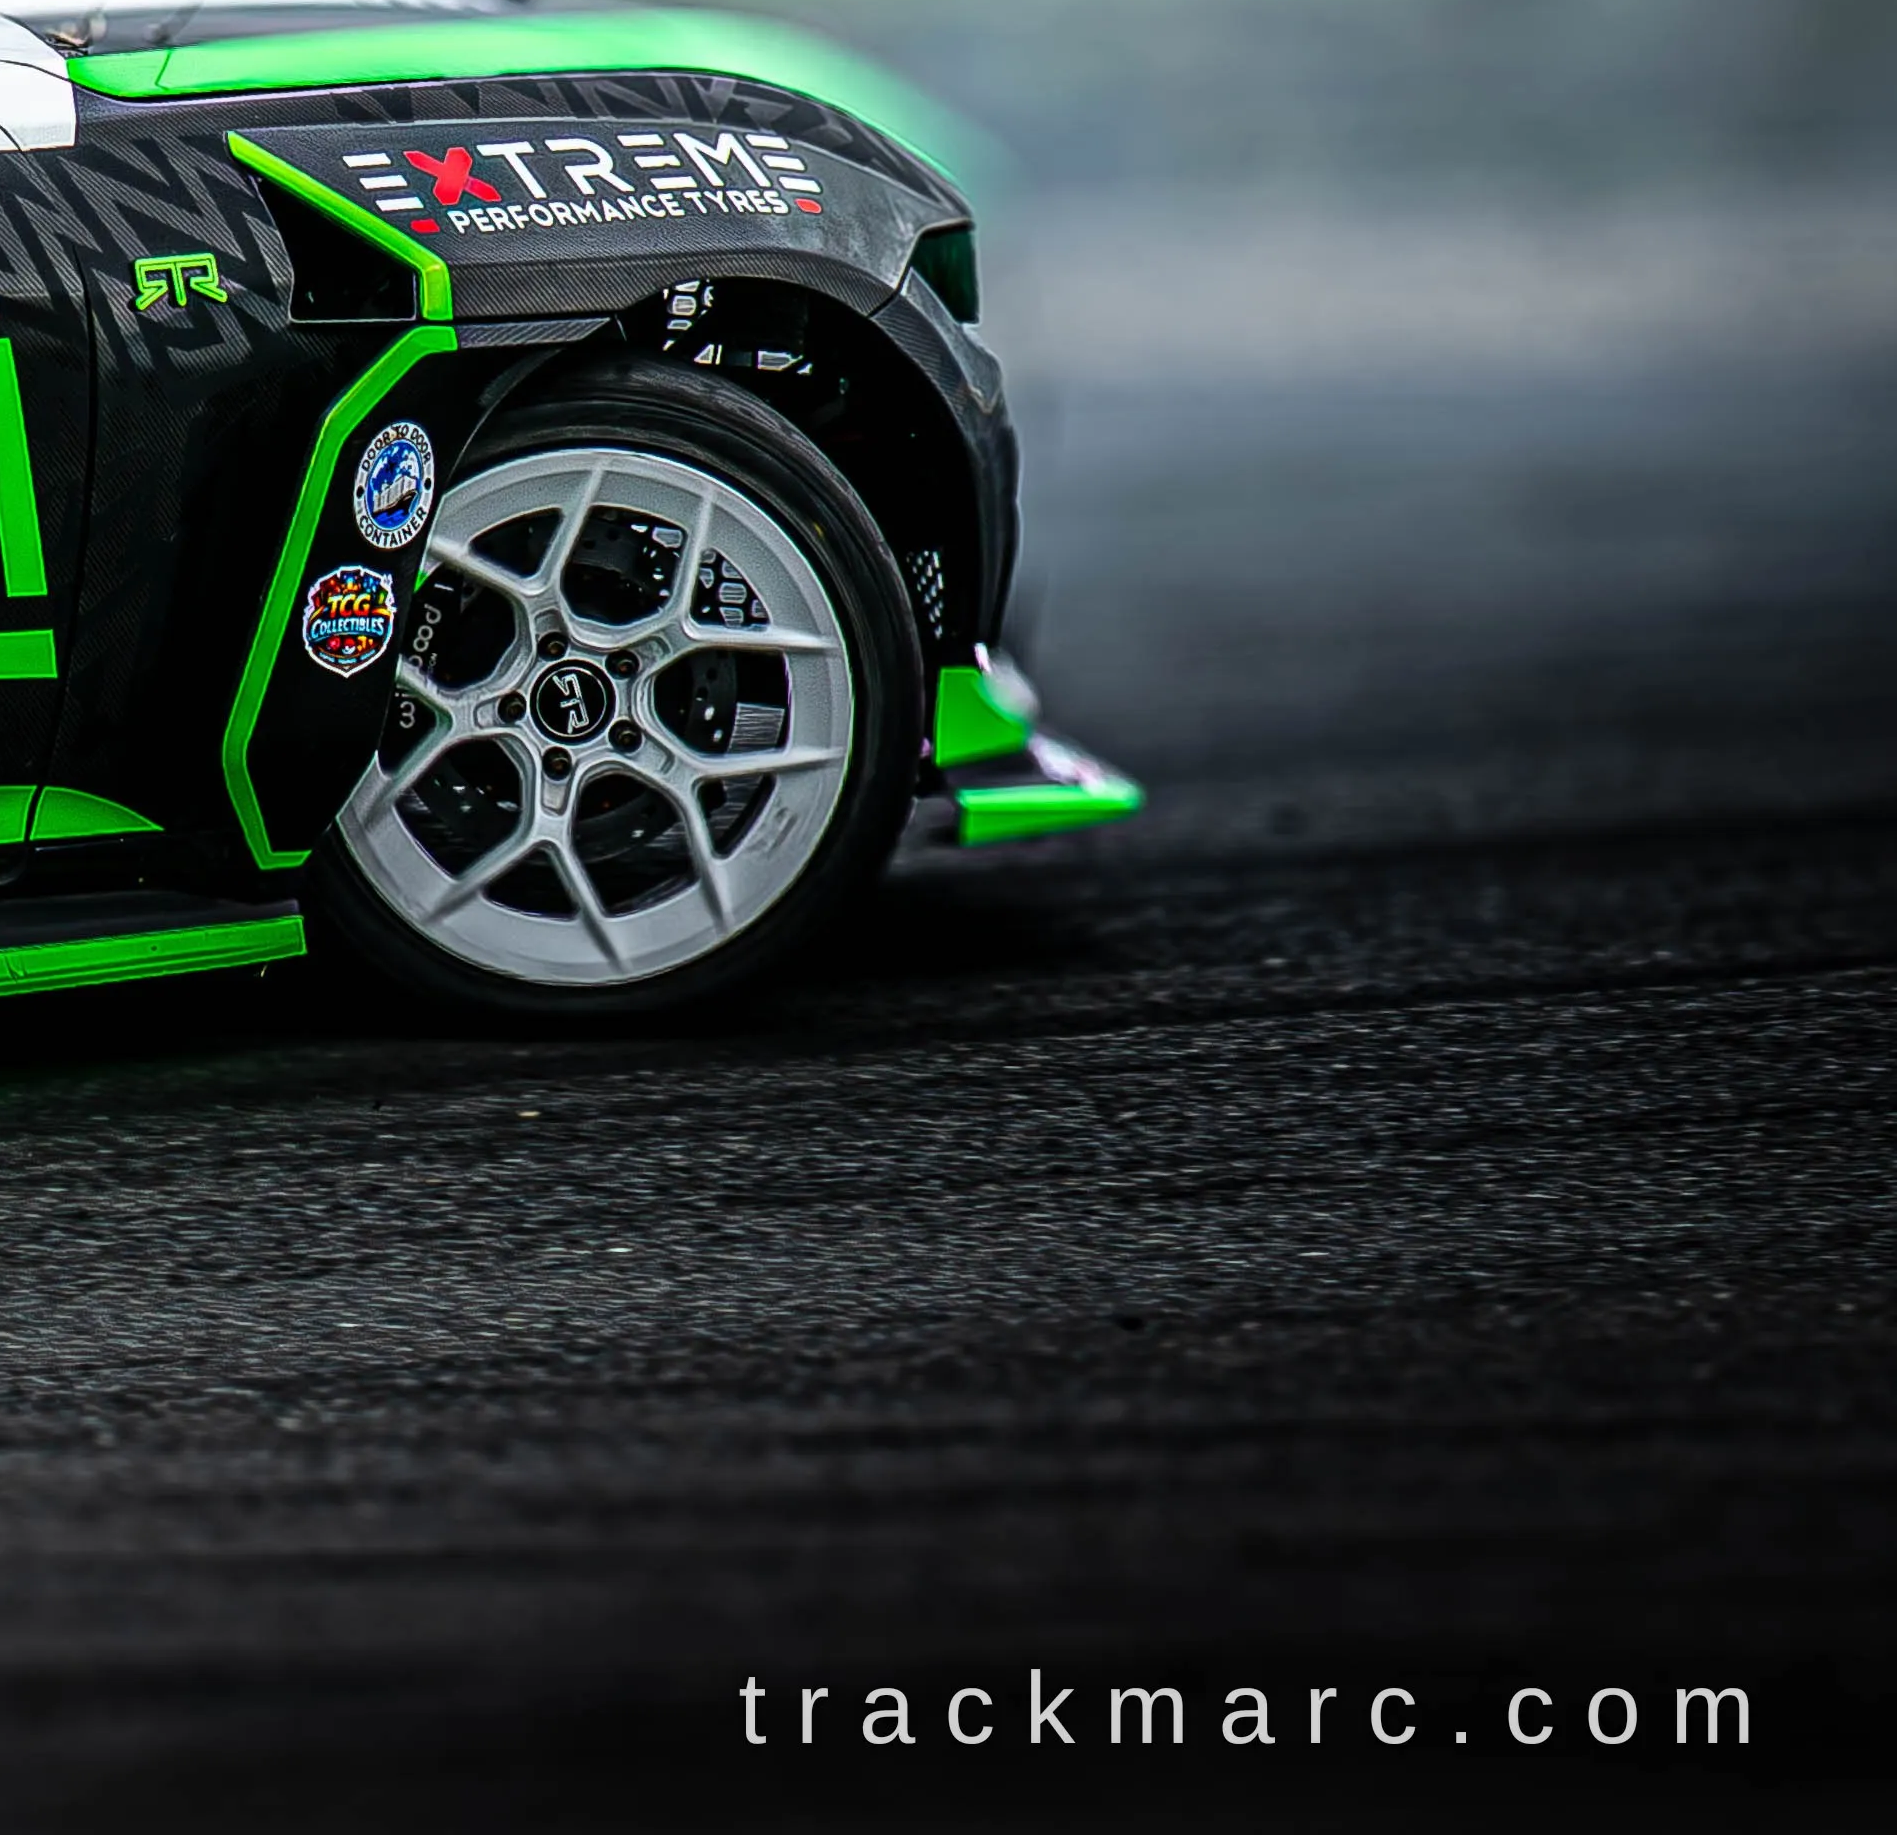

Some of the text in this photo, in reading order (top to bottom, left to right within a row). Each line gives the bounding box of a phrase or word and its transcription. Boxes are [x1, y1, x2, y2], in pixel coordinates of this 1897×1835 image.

[342, 131, 822, 214] EXTREME
[446, 189, 790, 235] PERFORMANCE TYRES
[361, 431, 391, 472] DOOR
[410, 428, 431, 465] DOOR
[359, 507, 427, 547] CONTAINER
[327, 593, 372, 618] TCG
[310, 616, 386, 639] COLLECTIBLES
